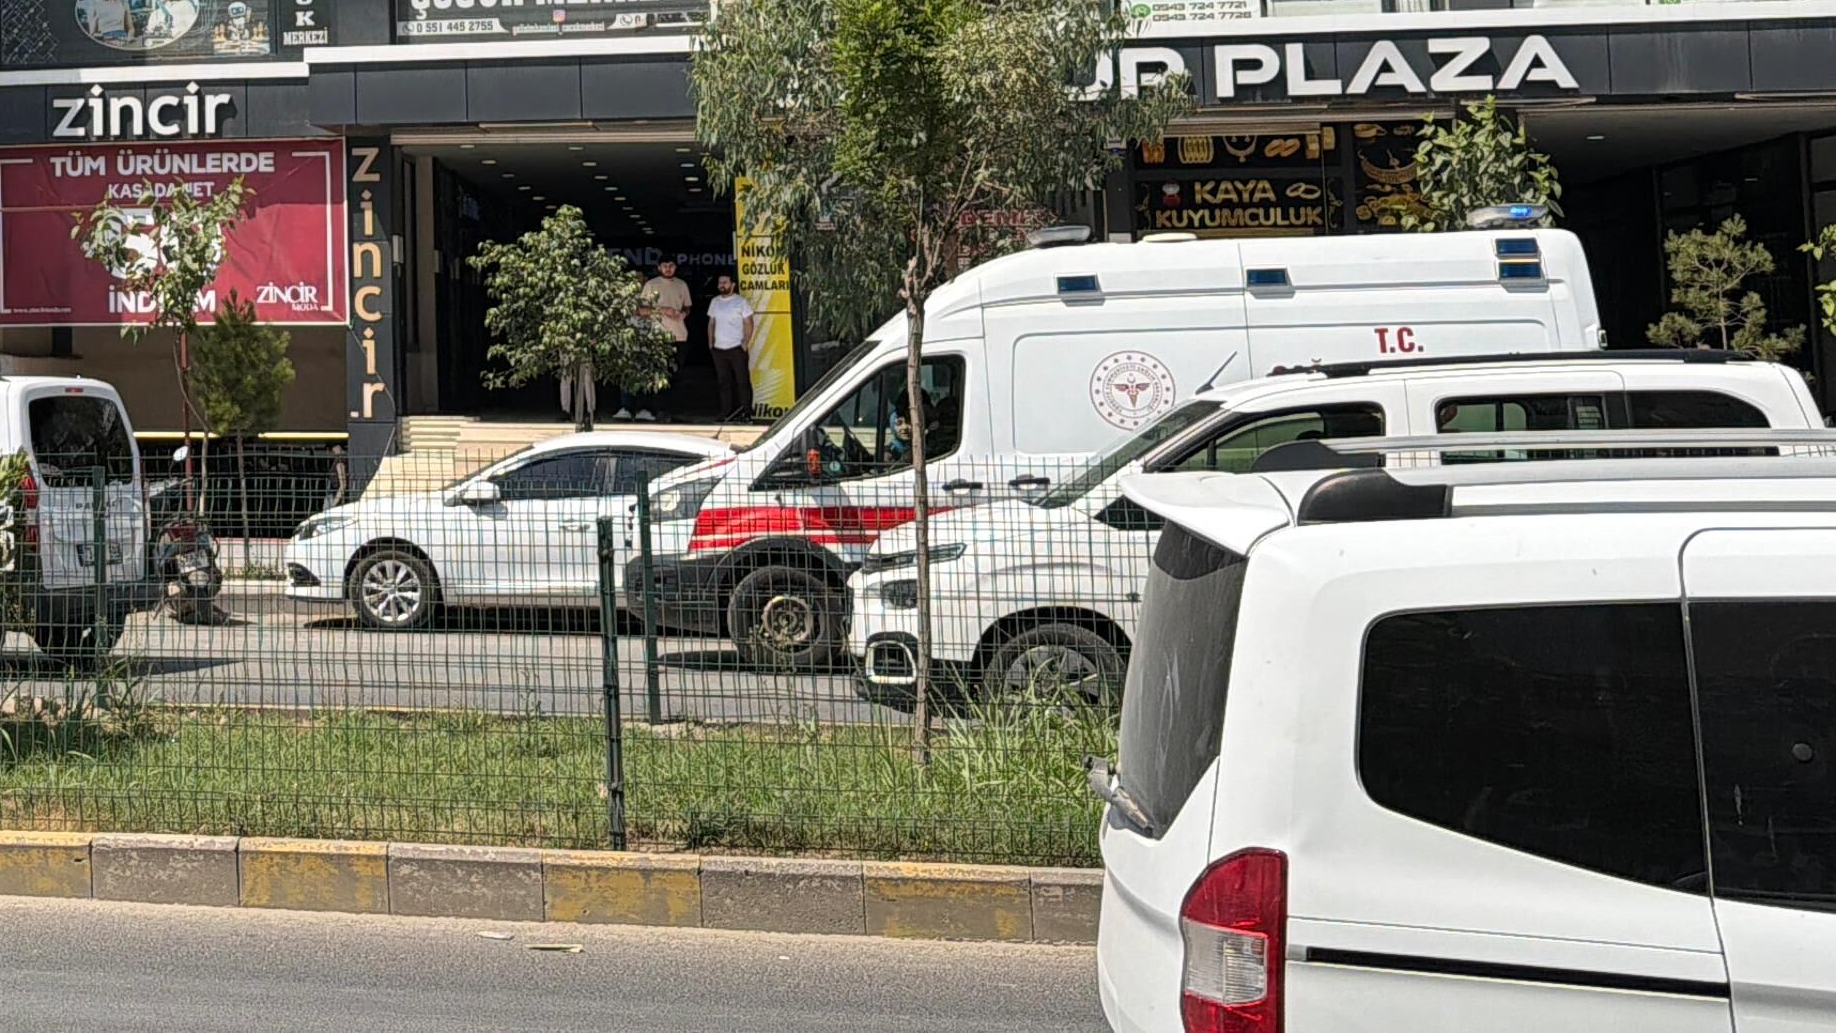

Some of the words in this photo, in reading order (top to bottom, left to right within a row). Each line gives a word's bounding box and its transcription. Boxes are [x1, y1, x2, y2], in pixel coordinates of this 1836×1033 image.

[283, 26, 328, 46] MERKEZİ
[1213, 34, 1581, 98] PLAZA
[52, 82, 231, 138] zincir
[50, 150, 106, 178] TÜM
[116, 148, 275, 176] ÜRÜNLERDE
[1194, 179, 1277, 204] KAYA
[1155, 205, 1324, 229] KUYUMCULUK
[257, 280, 318, 304] ZİNCİR
[1375, 326, 1424, 354] T.C.
